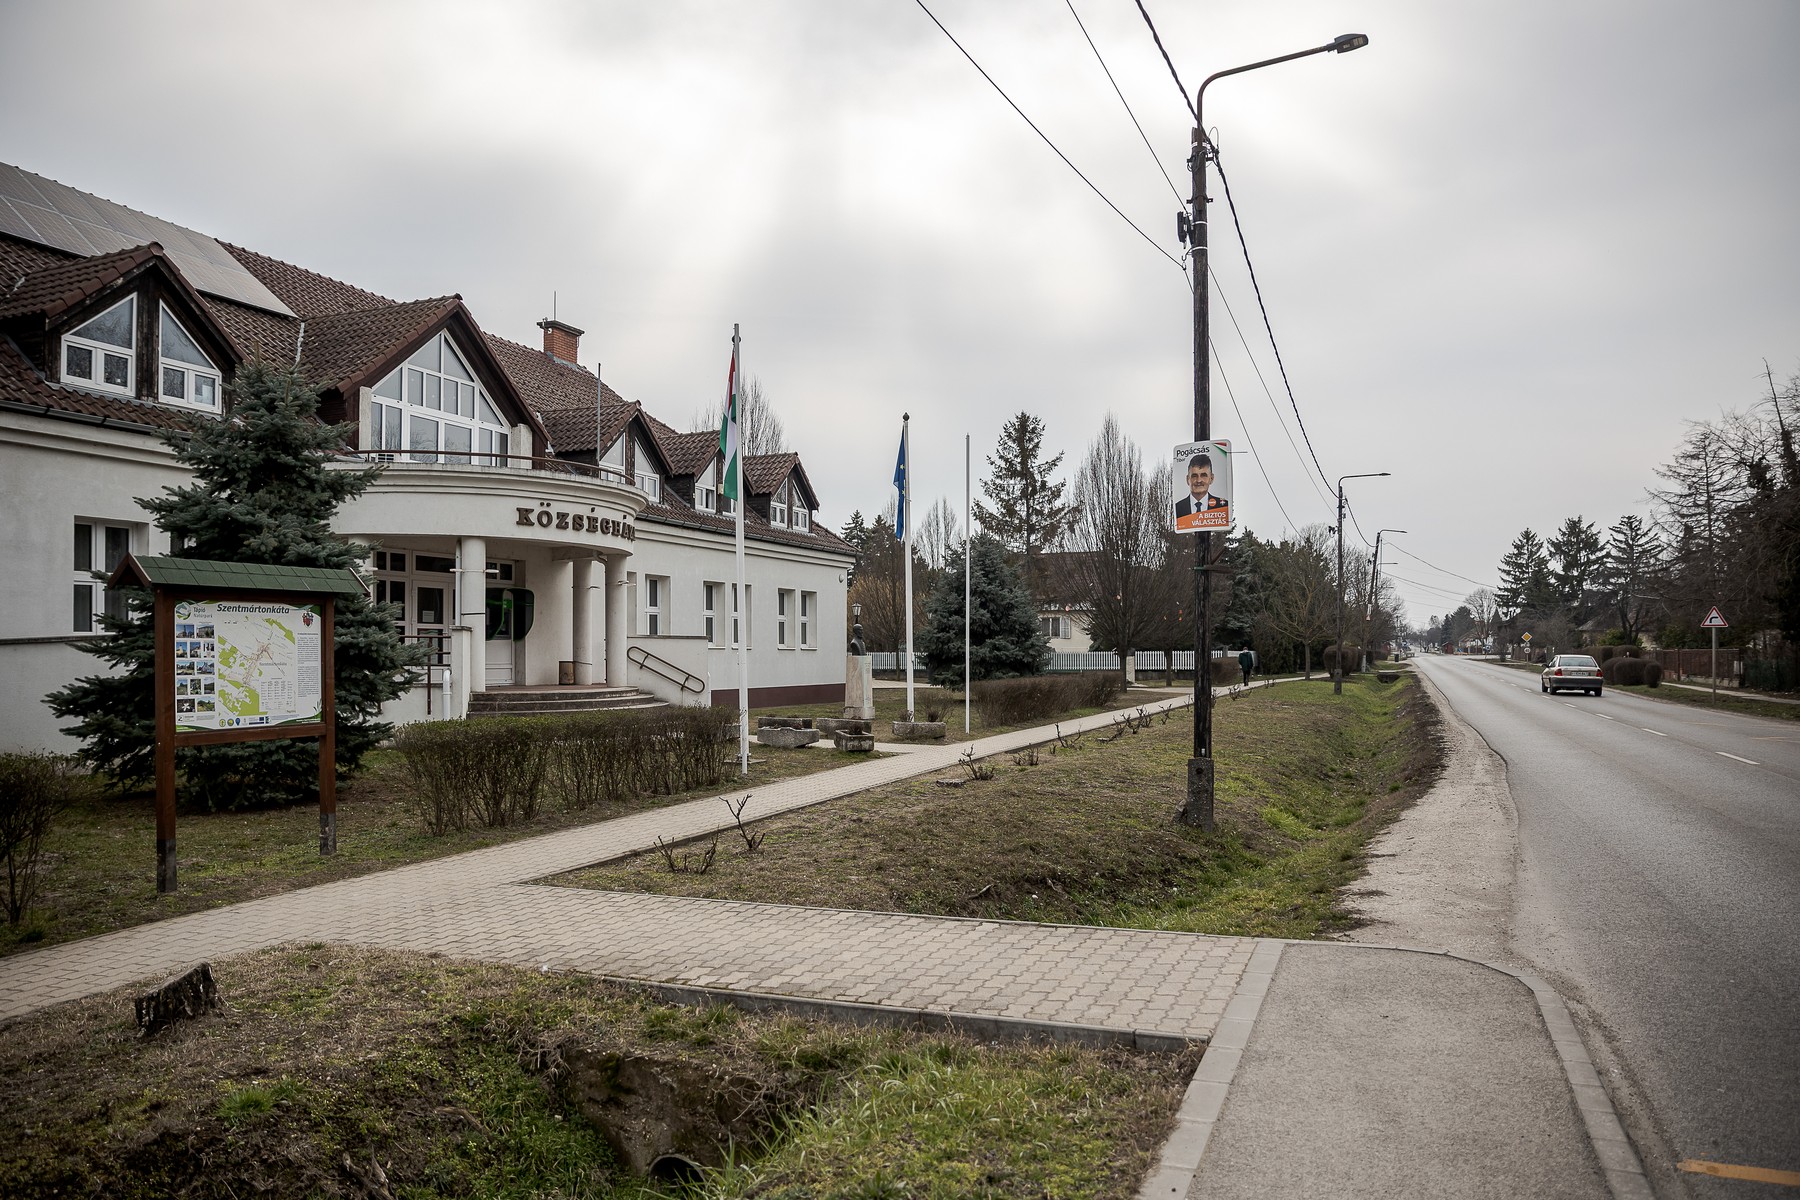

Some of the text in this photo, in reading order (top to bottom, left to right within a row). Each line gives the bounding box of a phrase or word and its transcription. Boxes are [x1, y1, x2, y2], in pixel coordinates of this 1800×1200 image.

[1176, 445, 1210, 457] Pogácsás
[1204, 511, 1227, 519] BIZTOS
[516, 501, 636, 542] KÖZSÉGHÁZ
[216, 603, 290, 614] Szentmártonkáta
